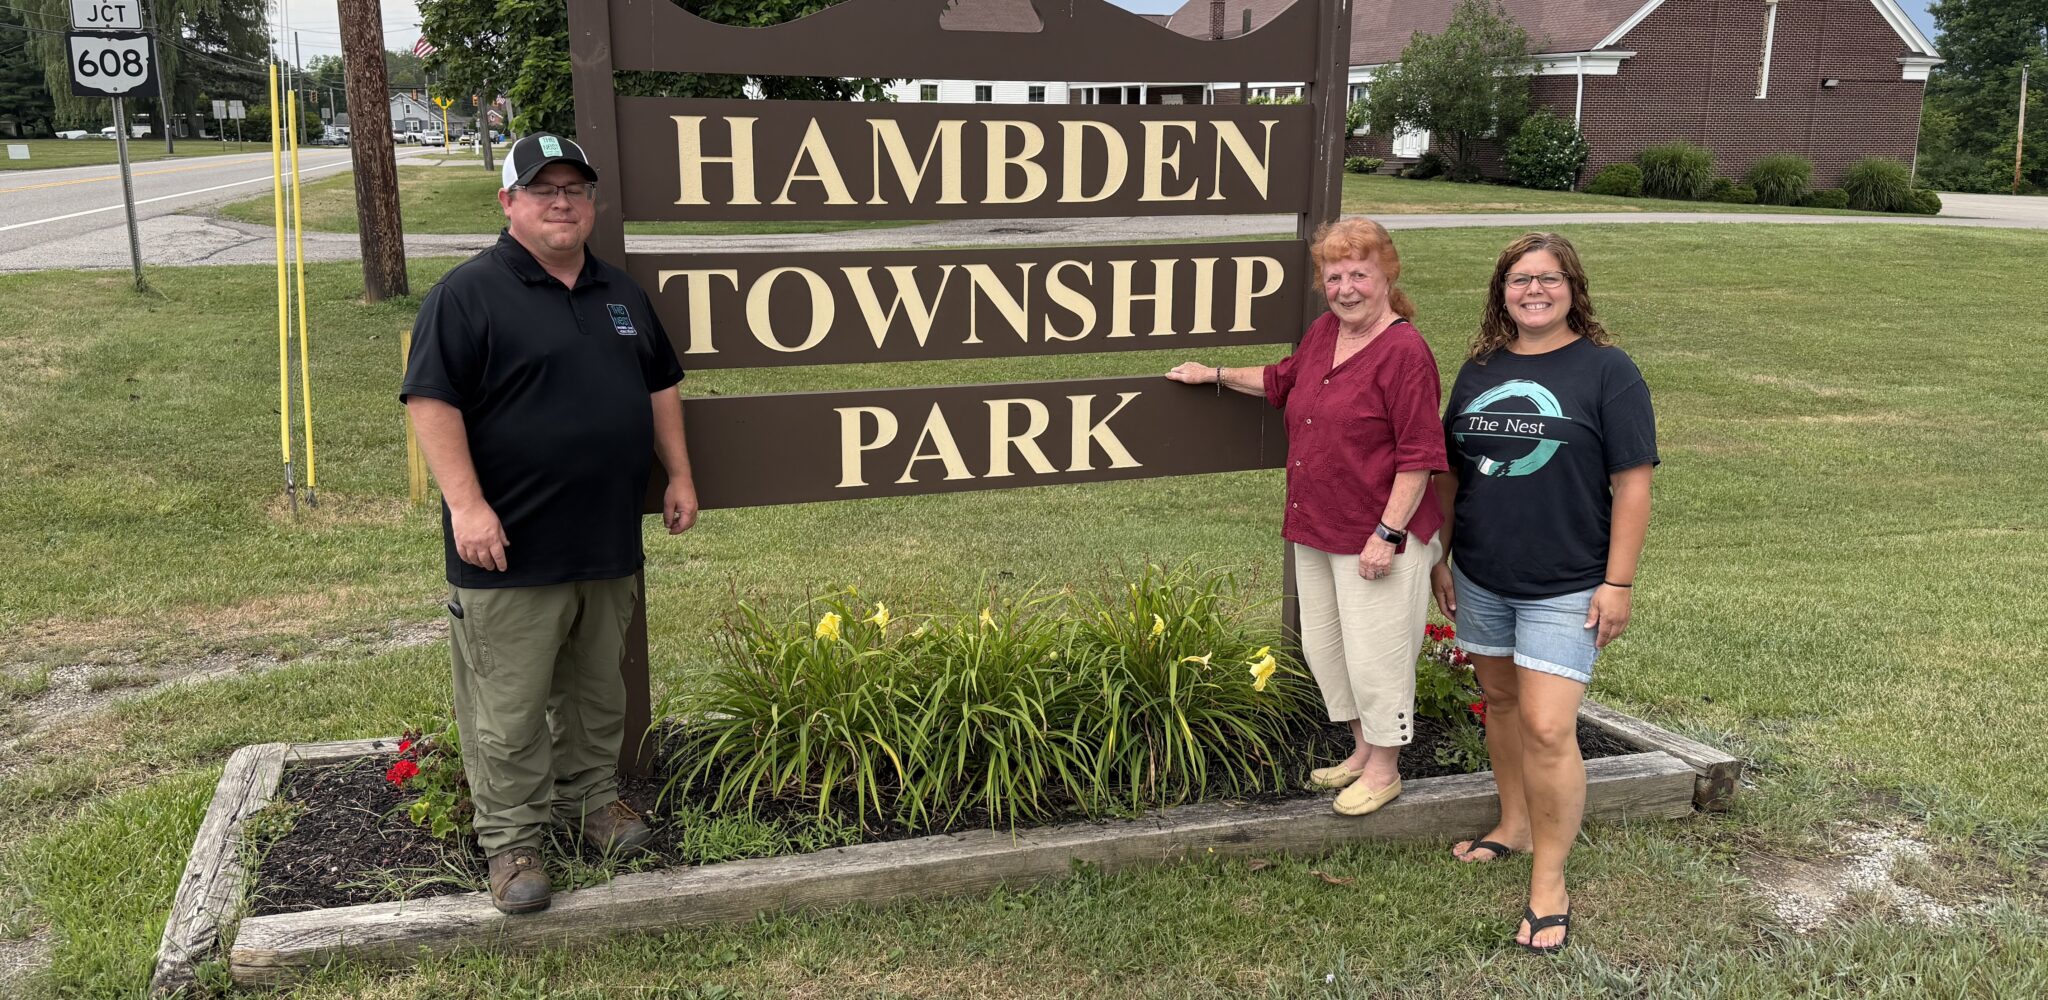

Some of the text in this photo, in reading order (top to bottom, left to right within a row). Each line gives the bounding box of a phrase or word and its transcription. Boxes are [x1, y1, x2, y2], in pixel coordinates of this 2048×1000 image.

[87, 5, 125, 22] JCT
[78, 49, 143, 77] 608
[672, 116, 1279, 205] HAMBDEN
[659, 257, 1285, 354] TOWNSHIP
[834, 392, 1142, 488] PARK
[1468, 416, 1545, 435] The Nest
